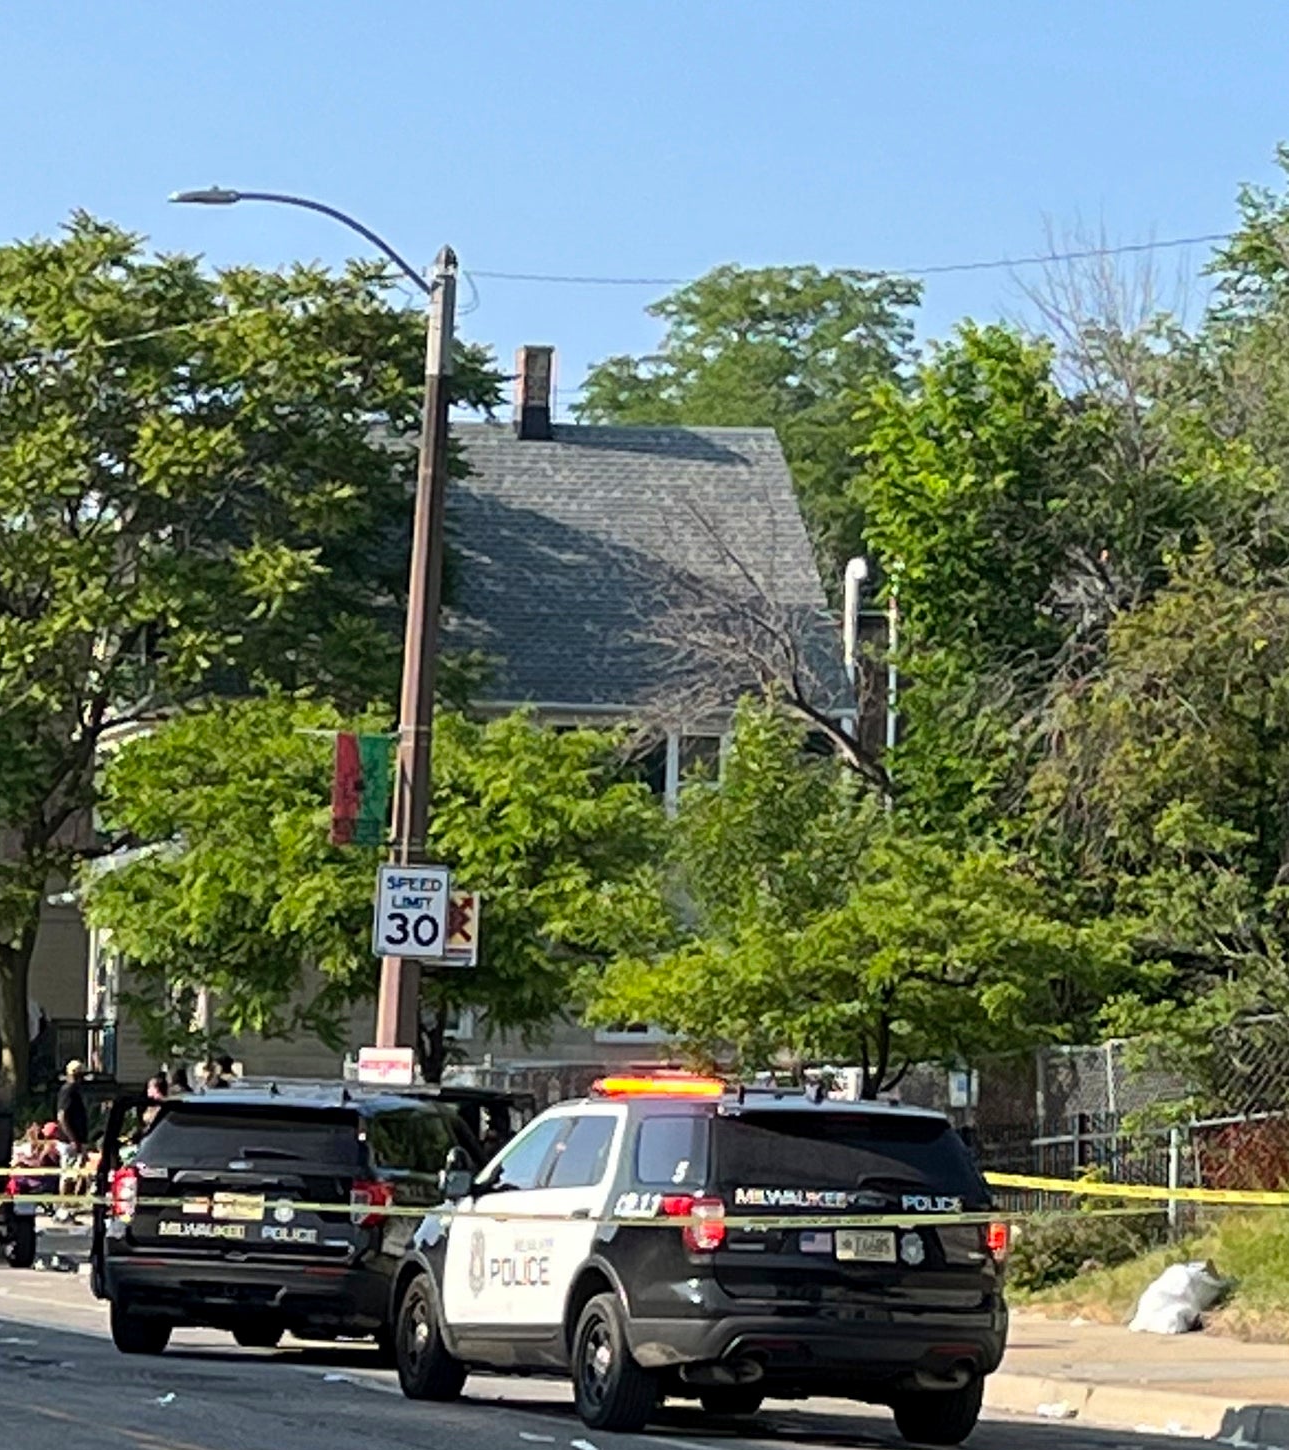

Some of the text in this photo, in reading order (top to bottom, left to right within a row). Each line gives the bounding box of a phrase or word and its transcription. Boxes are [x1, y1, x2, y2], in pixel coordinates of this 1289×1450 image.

[387, 876, 443, 892] SPEED
[391, 895, 433, 910] LIMIT
[385, 912, 439, 947] 30
[735, 1188, 963, 1213] MILWAUKEE POLICE
[158, 1221, 318, 1243] MILWAUKEE POLICE
[490, 1256, 551, 1286] POLICE
